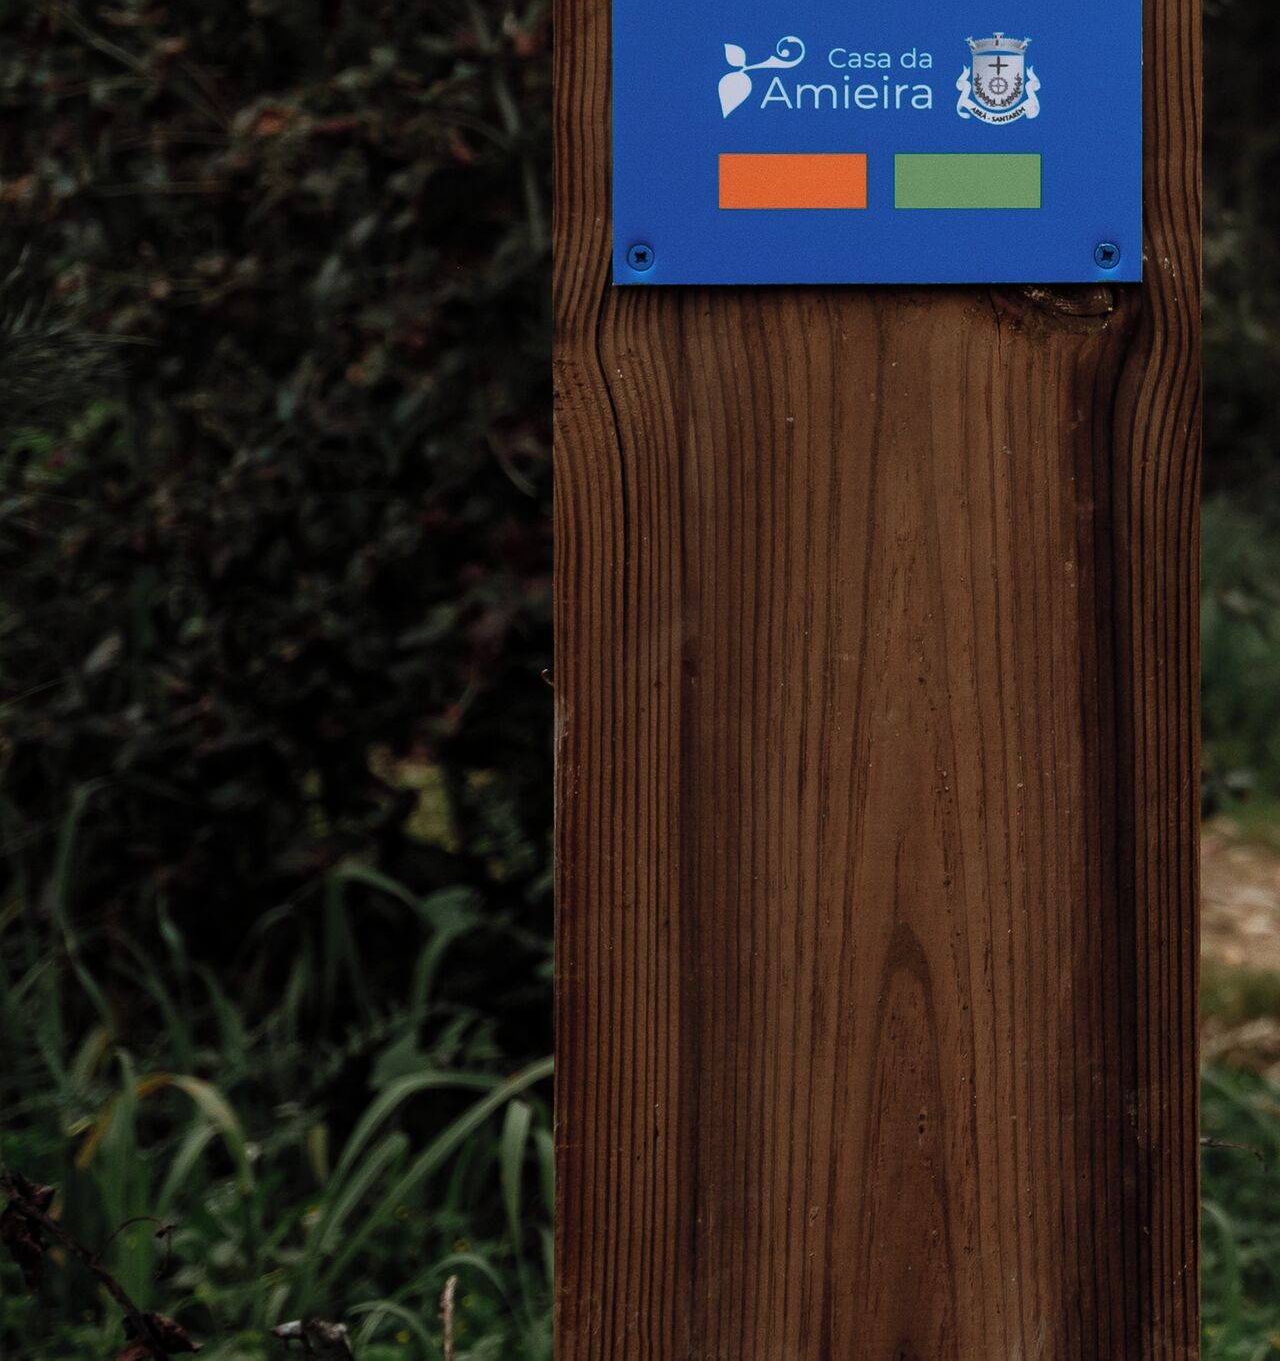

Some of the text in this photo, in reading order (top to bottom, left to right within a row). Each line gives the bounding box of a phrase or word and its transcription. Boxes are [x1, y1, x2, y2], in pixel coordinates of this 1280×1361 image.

[828, 47, 933, 69] Casa da
[760, 75, 933, 110] Amieira
